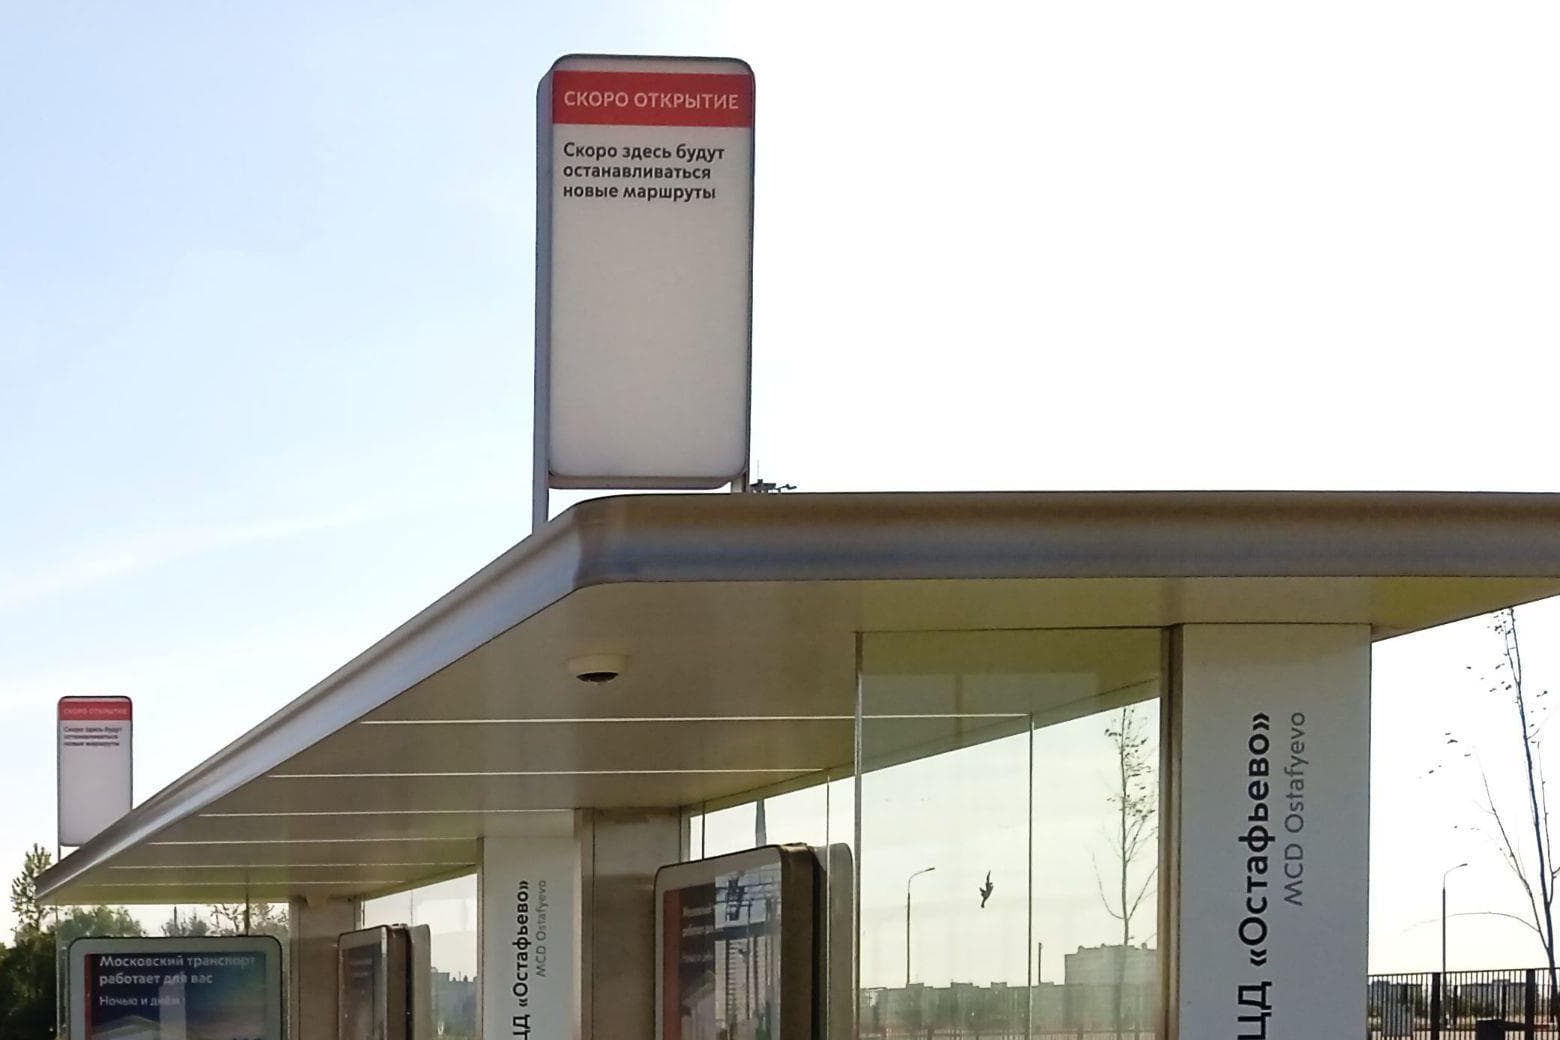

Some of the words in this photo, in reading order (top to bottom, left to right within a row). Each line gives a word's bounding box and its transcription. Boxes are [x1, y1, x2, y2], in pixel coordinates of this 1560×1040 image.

[564, 91, 629, 107] СКОРО
[634, 92, 739, 109] ОТКРЫТИЕ
[563, 142, 618, 160] Скоро
[622, 145, 672, 161] здесь
[676, 143, 725, 162] будут
[563, 164, 711, 180] останавливаться
[563, 185, 619, 198] новые
[623, 186, 716, 202] маршруты
[1284, 712, 1309, 833] Ostafyevo
[1238, 712, 1276, 967] «Остафьево»
[1284, 843, 1304, 907] MCD
[512, 880, 531, 1008] «Остафьево»
[99, 955, 183, 967] Московский
[187, 956, 256, 968] транспорт
[536, 945, 546, 977] MCD
[99, 972, 160, 986] работает
[191, 974, 213, 984] вас
